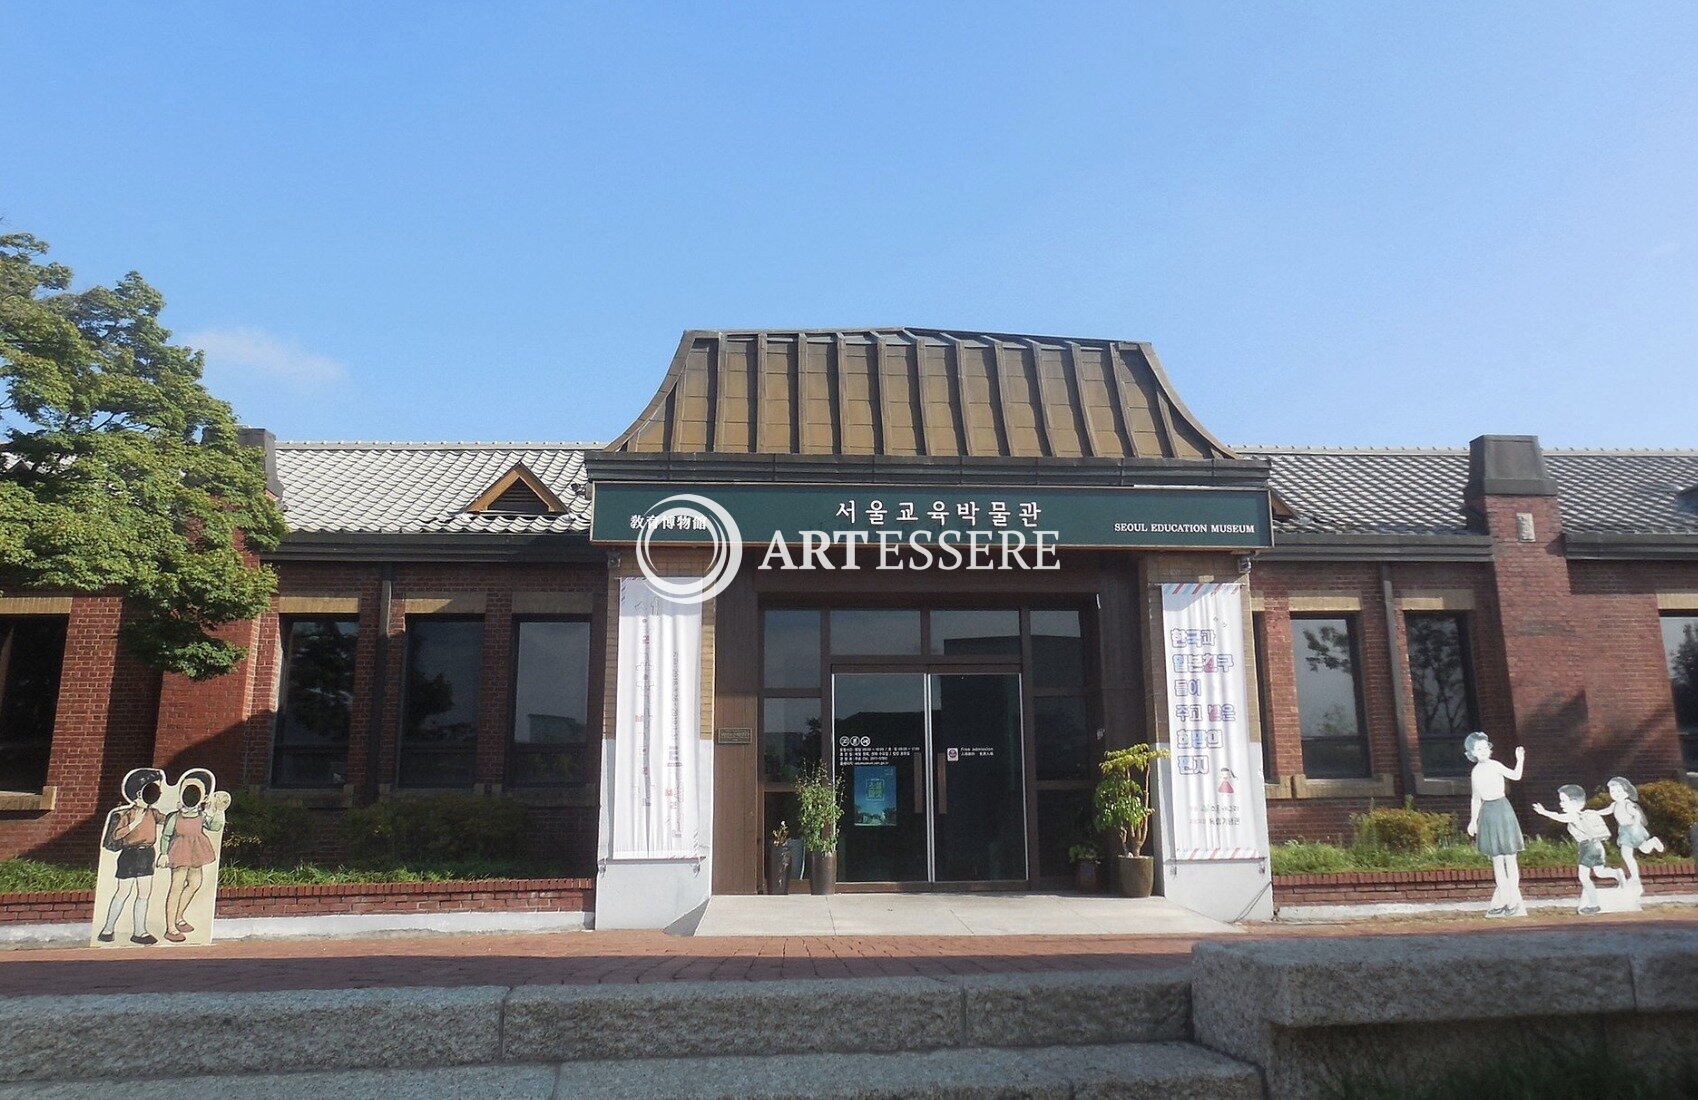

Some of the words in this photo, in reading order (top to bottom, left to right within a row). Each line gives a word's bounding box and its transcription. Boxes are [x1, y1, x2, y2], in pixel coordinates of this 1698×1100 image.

[835, 499, 1042, 528] 서울교육박물관
[1114, 523, 1148, 532] SEOUL
[1150, 523, 1208, 533] EDUCATION
[1210, 524, 1255, 533] MUSEUM
[1176, 704, 1203, 722] 주고
